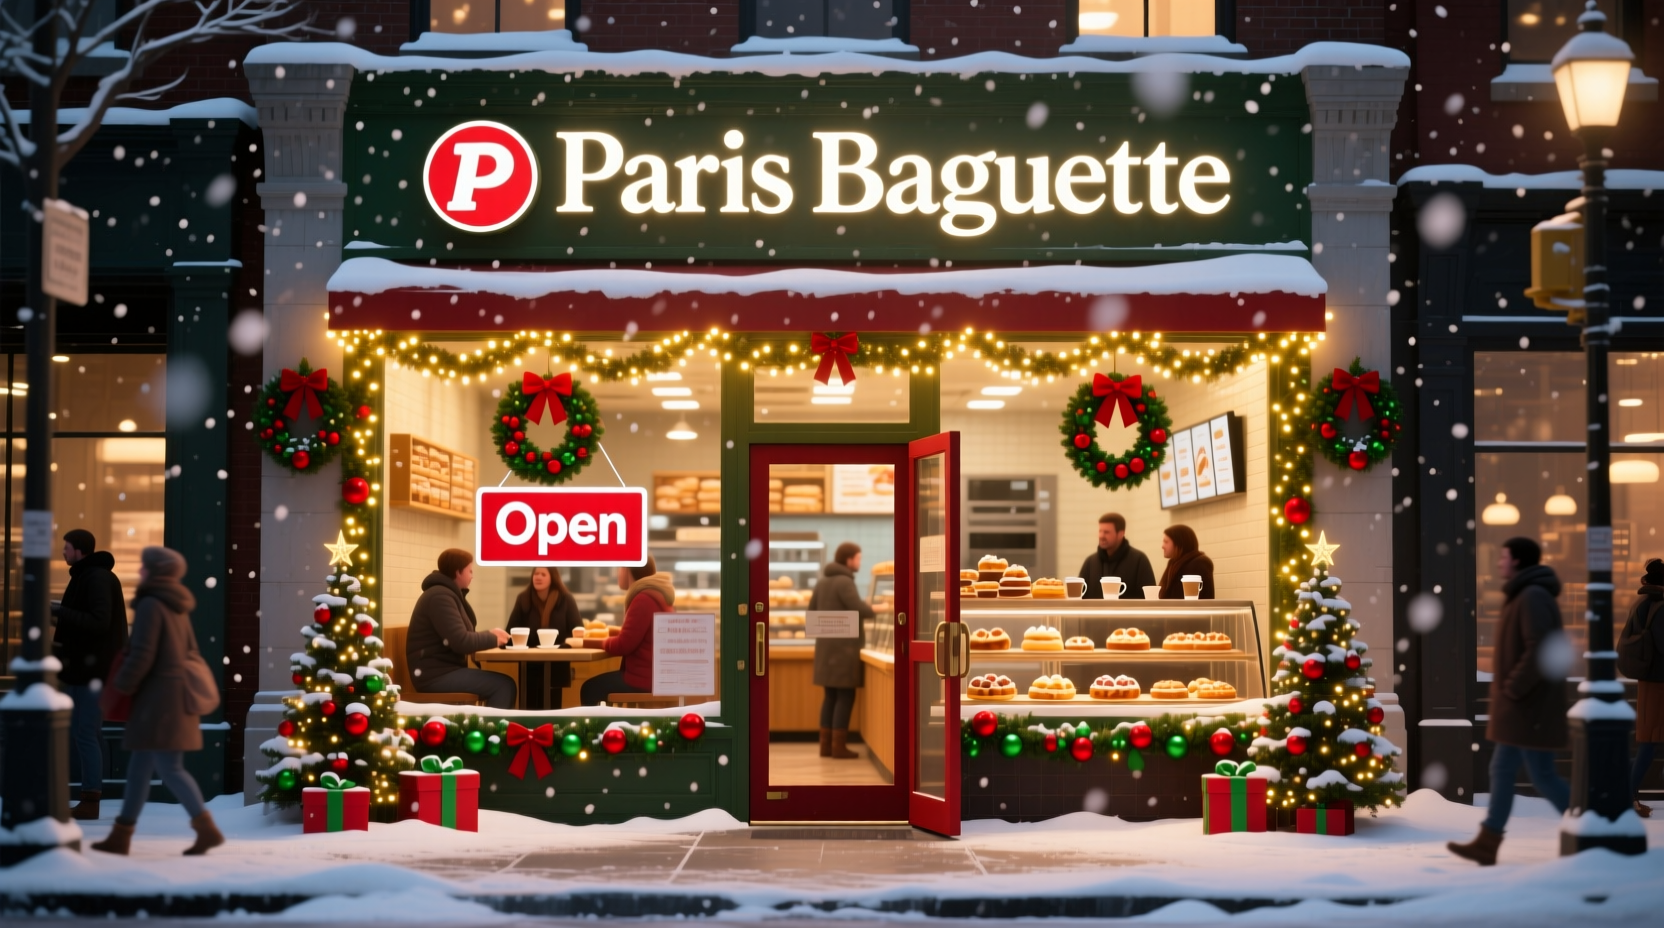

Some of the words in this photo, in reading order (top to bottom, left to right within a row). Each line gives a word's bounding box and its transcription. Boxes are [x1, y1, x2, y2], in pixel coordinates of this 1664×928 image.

[446, 142, 515, 212] P
[556, 129, 794, 214] Paris
[812, 131, 1231, 237] Baguette
[495, 501, 627, 556] Open
